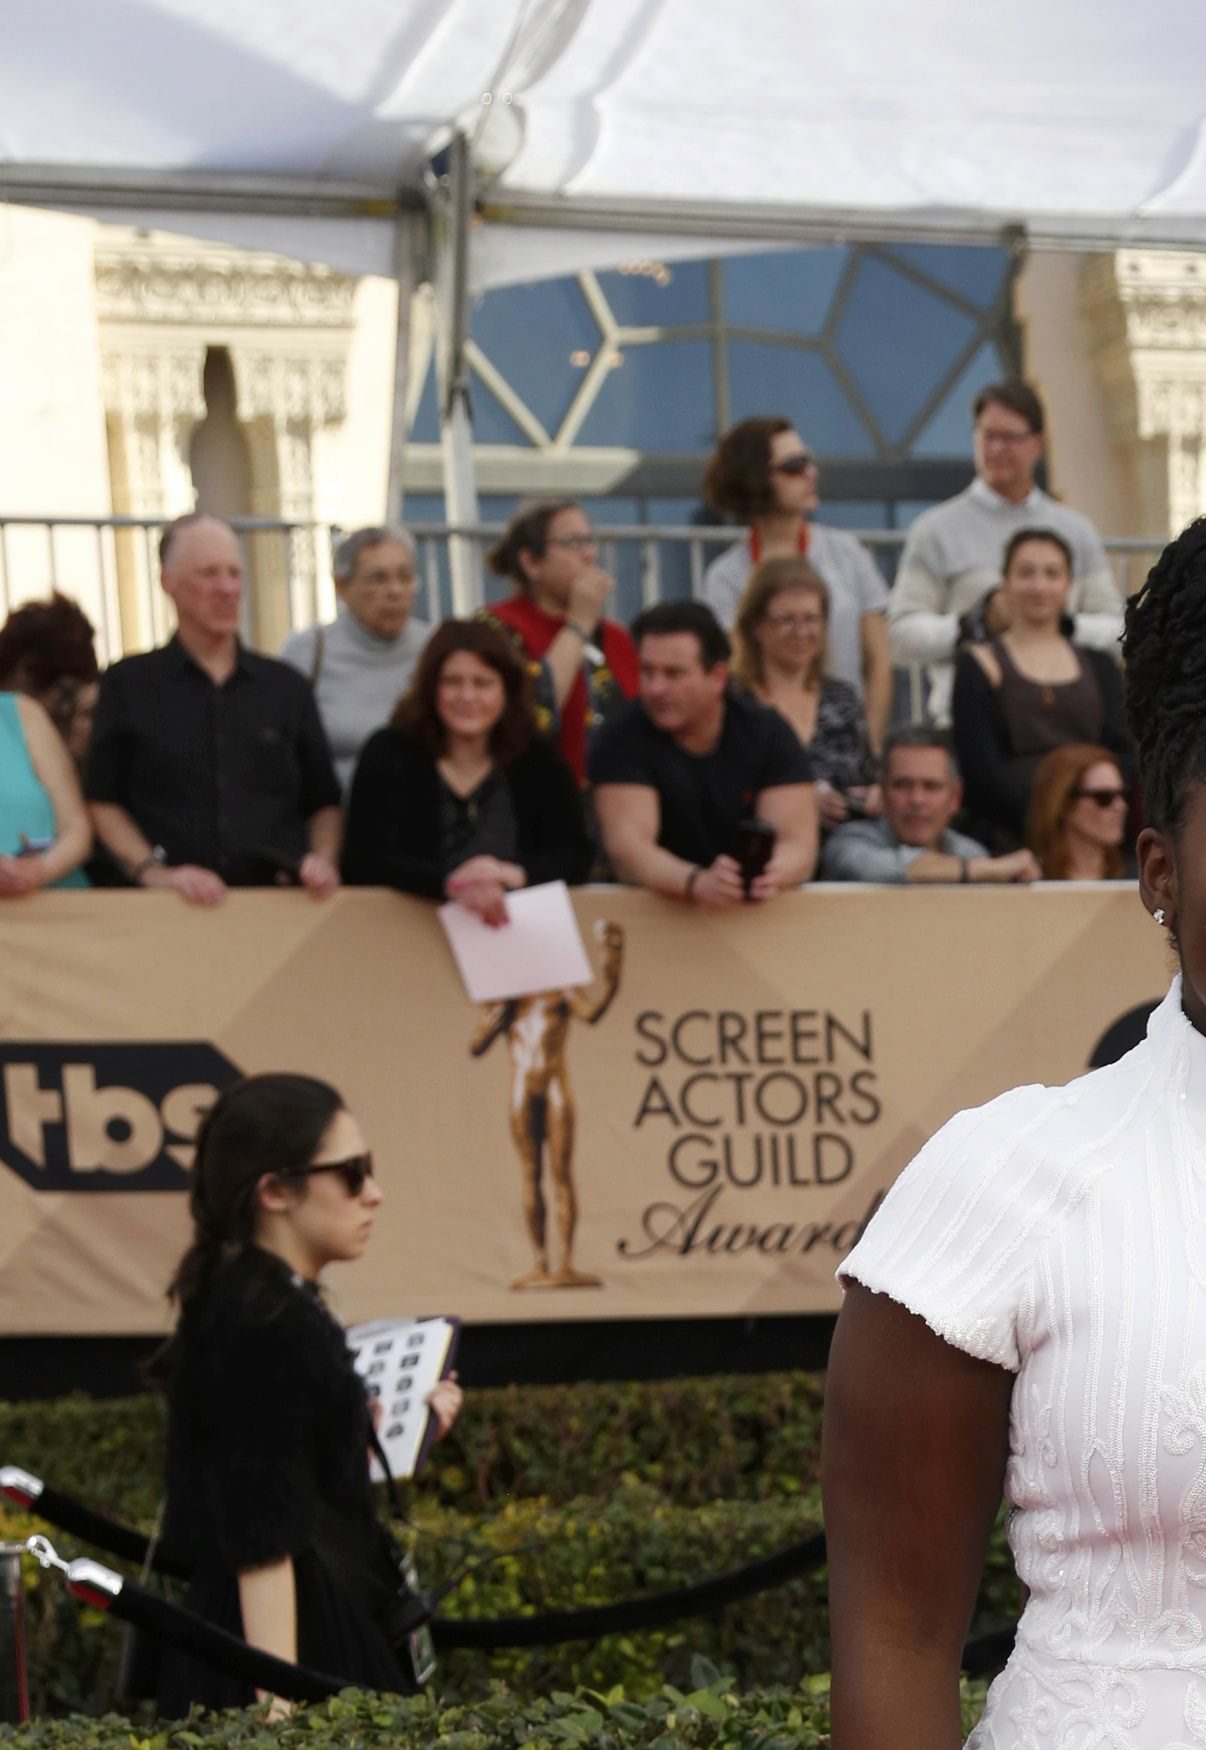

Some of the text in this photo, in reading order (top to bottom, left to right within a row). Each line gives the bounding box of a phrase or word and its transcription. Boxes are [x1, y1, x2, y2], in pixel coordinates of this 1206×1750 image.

[634, 1009, 873, 1067] SCREEN
[633, 1070, 881, 1127] ACTORS
[667, 1131, 854, 1189] GUILD
